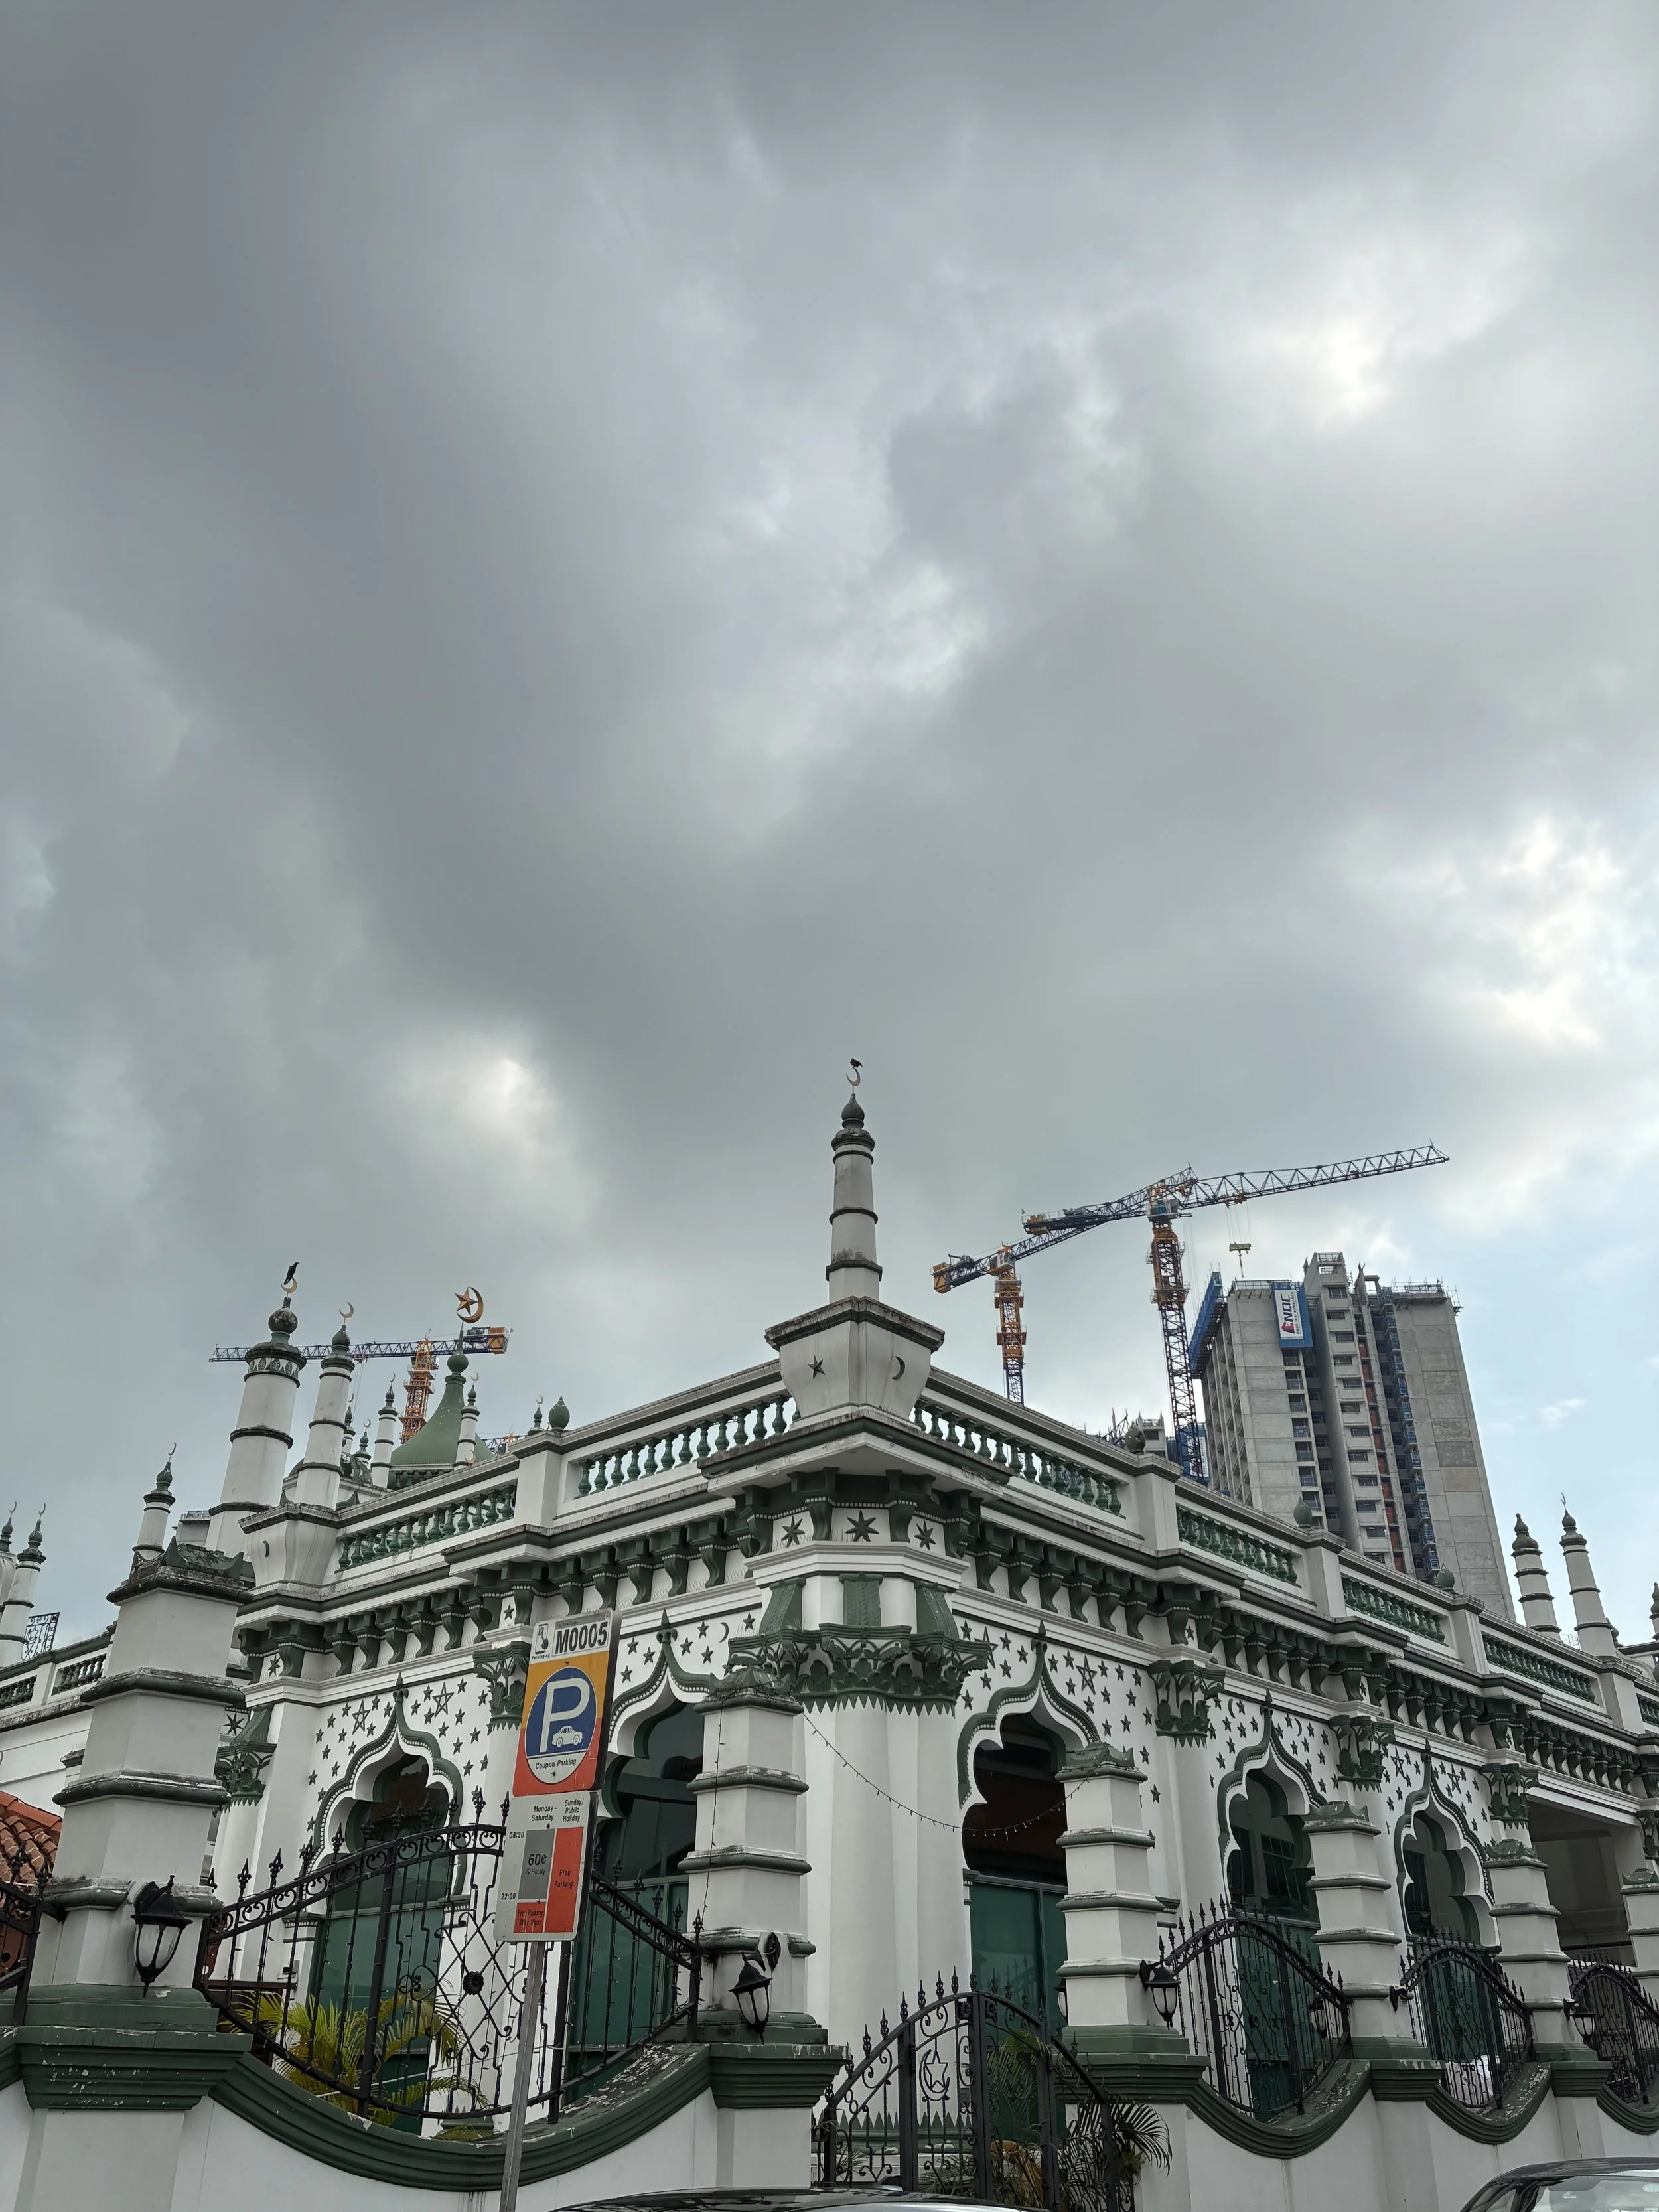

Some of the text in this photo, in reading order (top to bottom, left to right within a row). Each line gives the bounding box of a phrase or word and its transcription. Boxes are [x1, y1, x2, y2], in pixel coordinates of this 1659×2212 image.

[555, 1621, 608, 1655] M0005
[540, 1678, 590, 1753] P
[528, 1853, 547, 1866] 60¢
